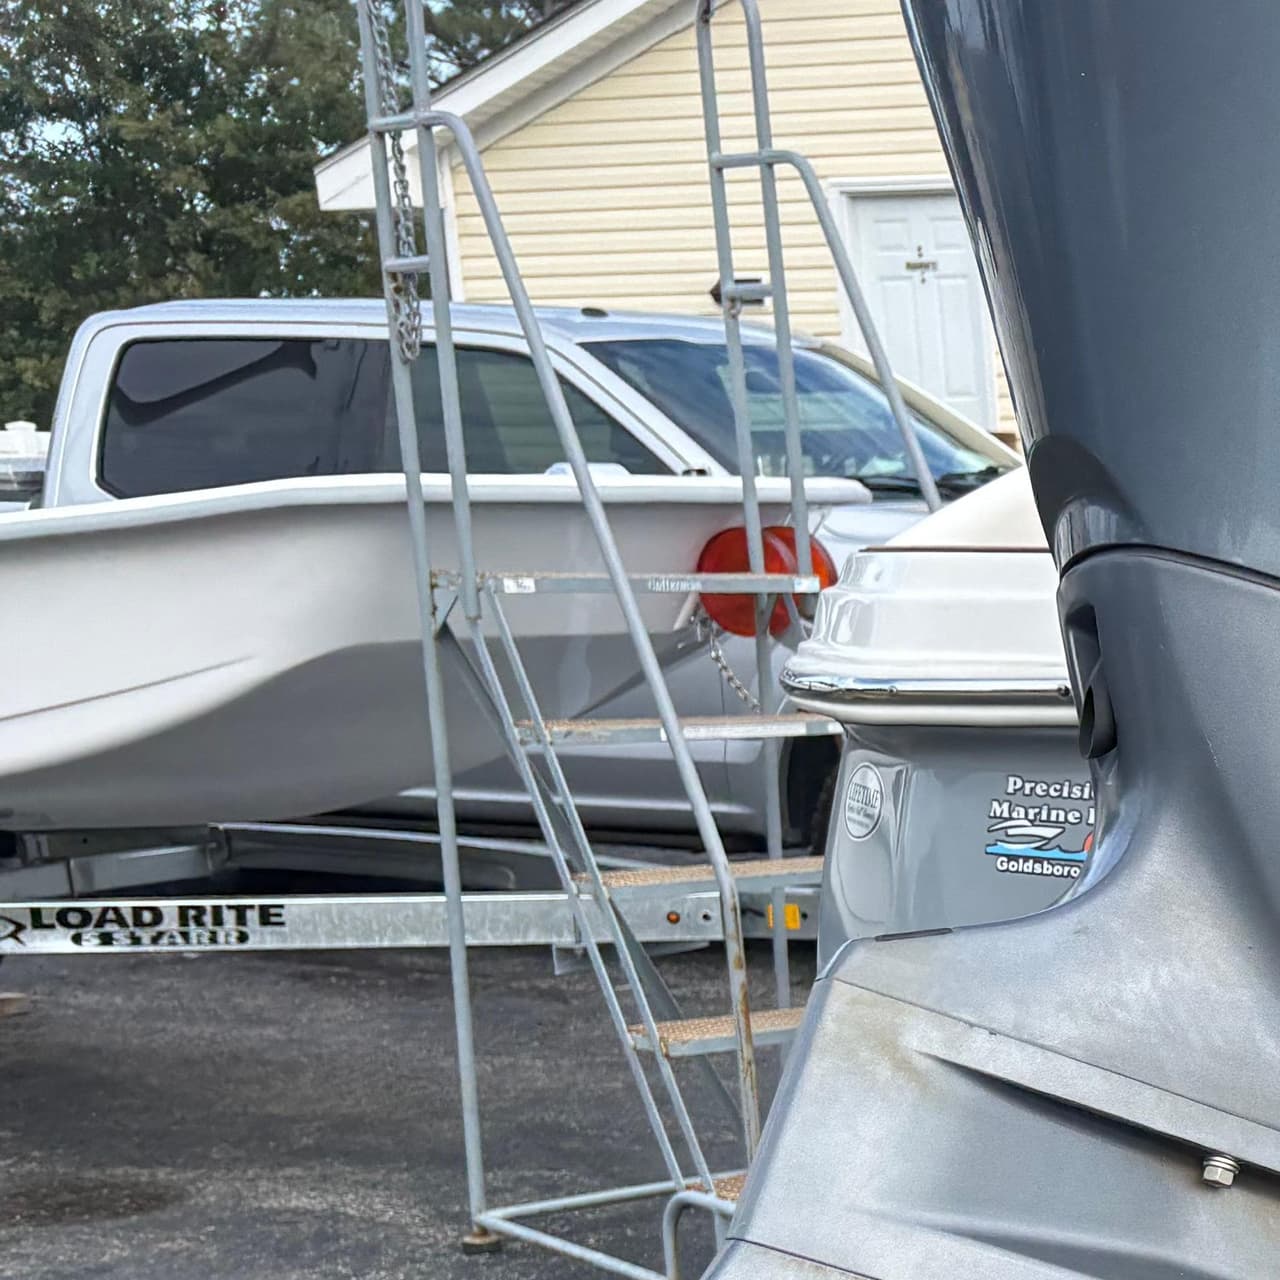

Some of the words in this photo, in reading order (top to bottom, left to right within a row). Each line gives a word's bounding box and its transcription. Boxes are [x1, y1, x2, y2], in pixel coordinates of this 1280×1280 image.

[1006, 775, 1095, 799] Precisi
[988, 800, 1082, 824] Marine
[996, 857, 1081, 878] Goldsboro
[30, 906, 164, 929] LOAD
[178, 904, 286, 927] RITE
